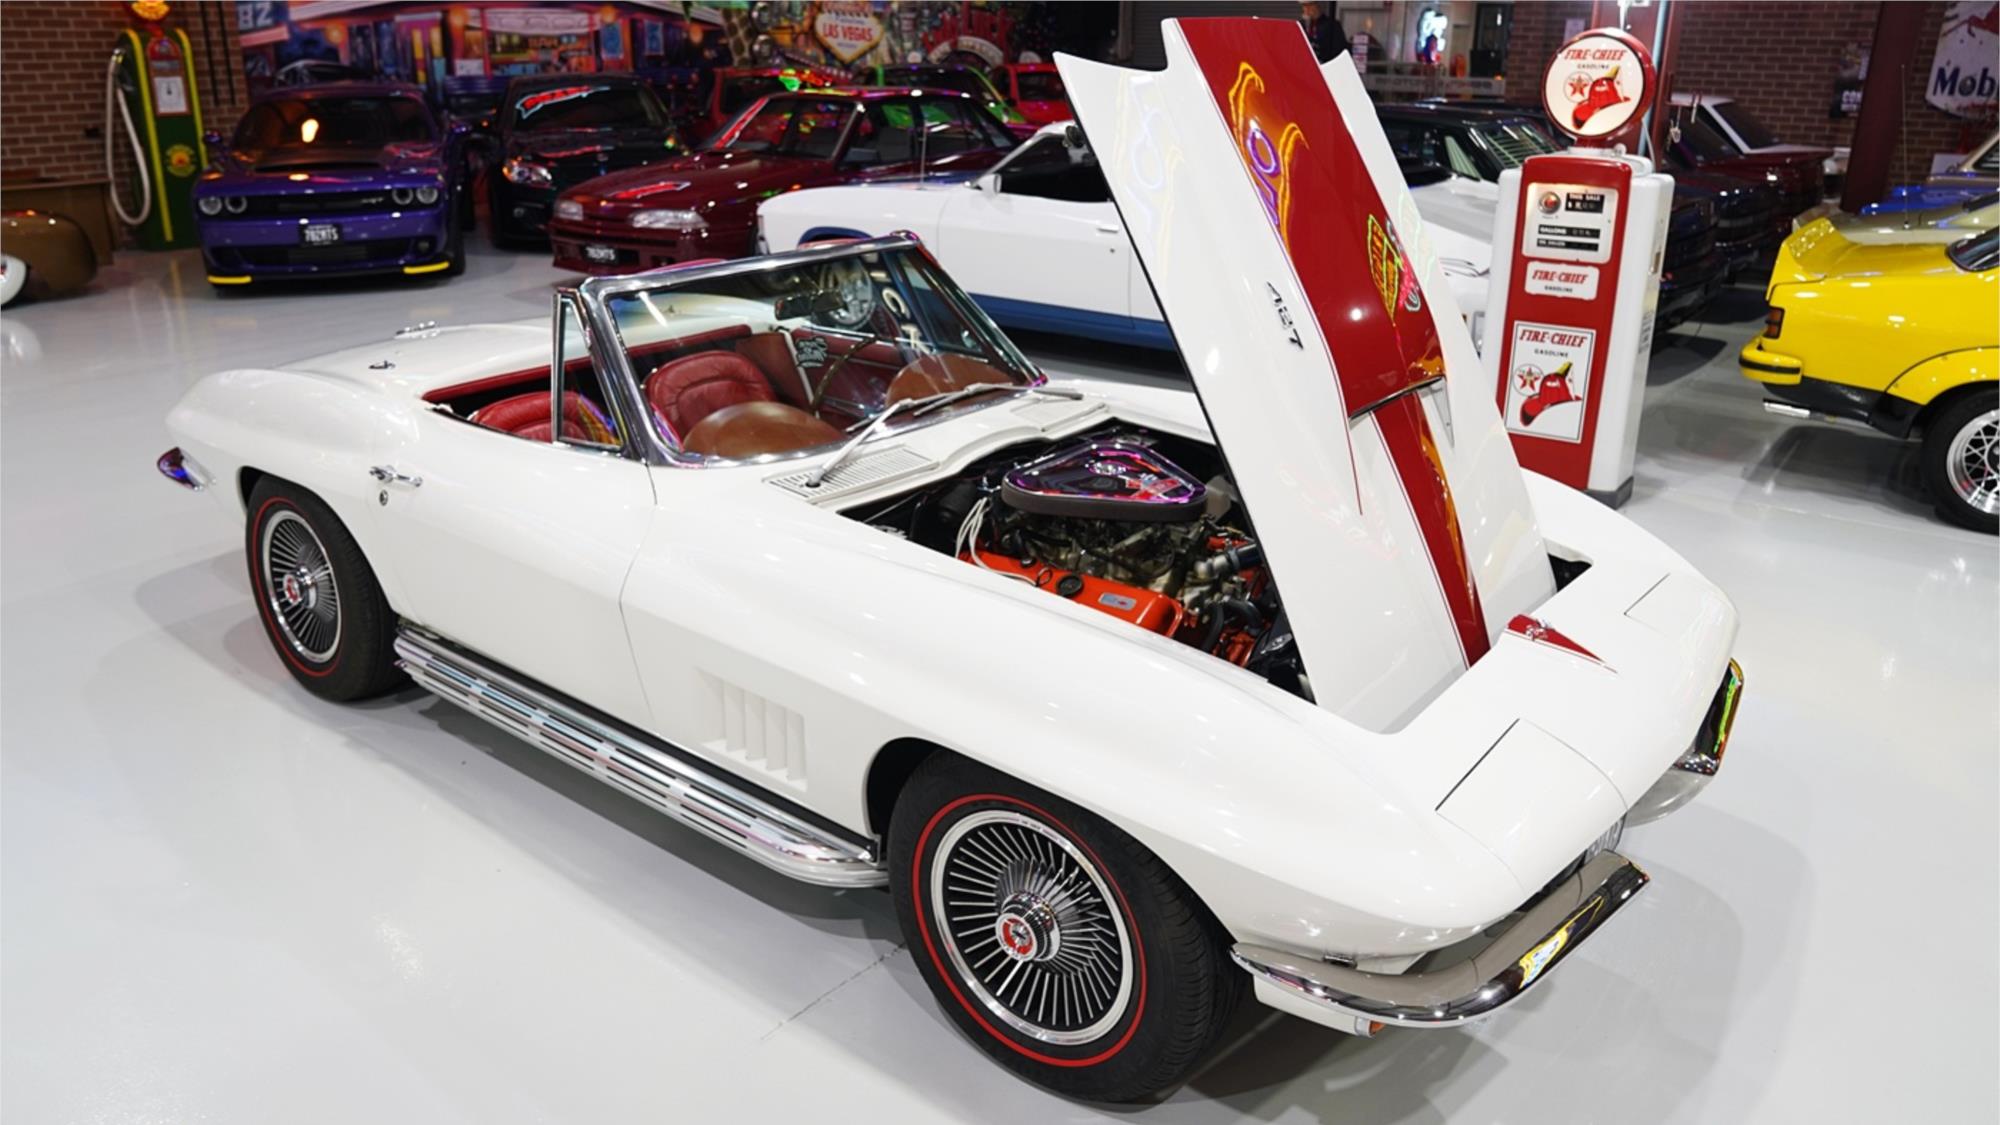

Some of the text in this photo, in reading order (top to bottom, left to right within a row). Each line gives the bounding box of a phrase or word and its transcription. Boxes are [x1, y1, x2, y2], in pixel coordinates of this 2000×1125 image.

[823, 22, 873, 41] LAS VEGAS
[1932, 65, 1998, 97] Mob
[1266, 280, 1304, 350] 427
[1519, 328, 1589, 348] FIRE-CHIEF
[1534, 348, 1568, 358] GASOLINE
